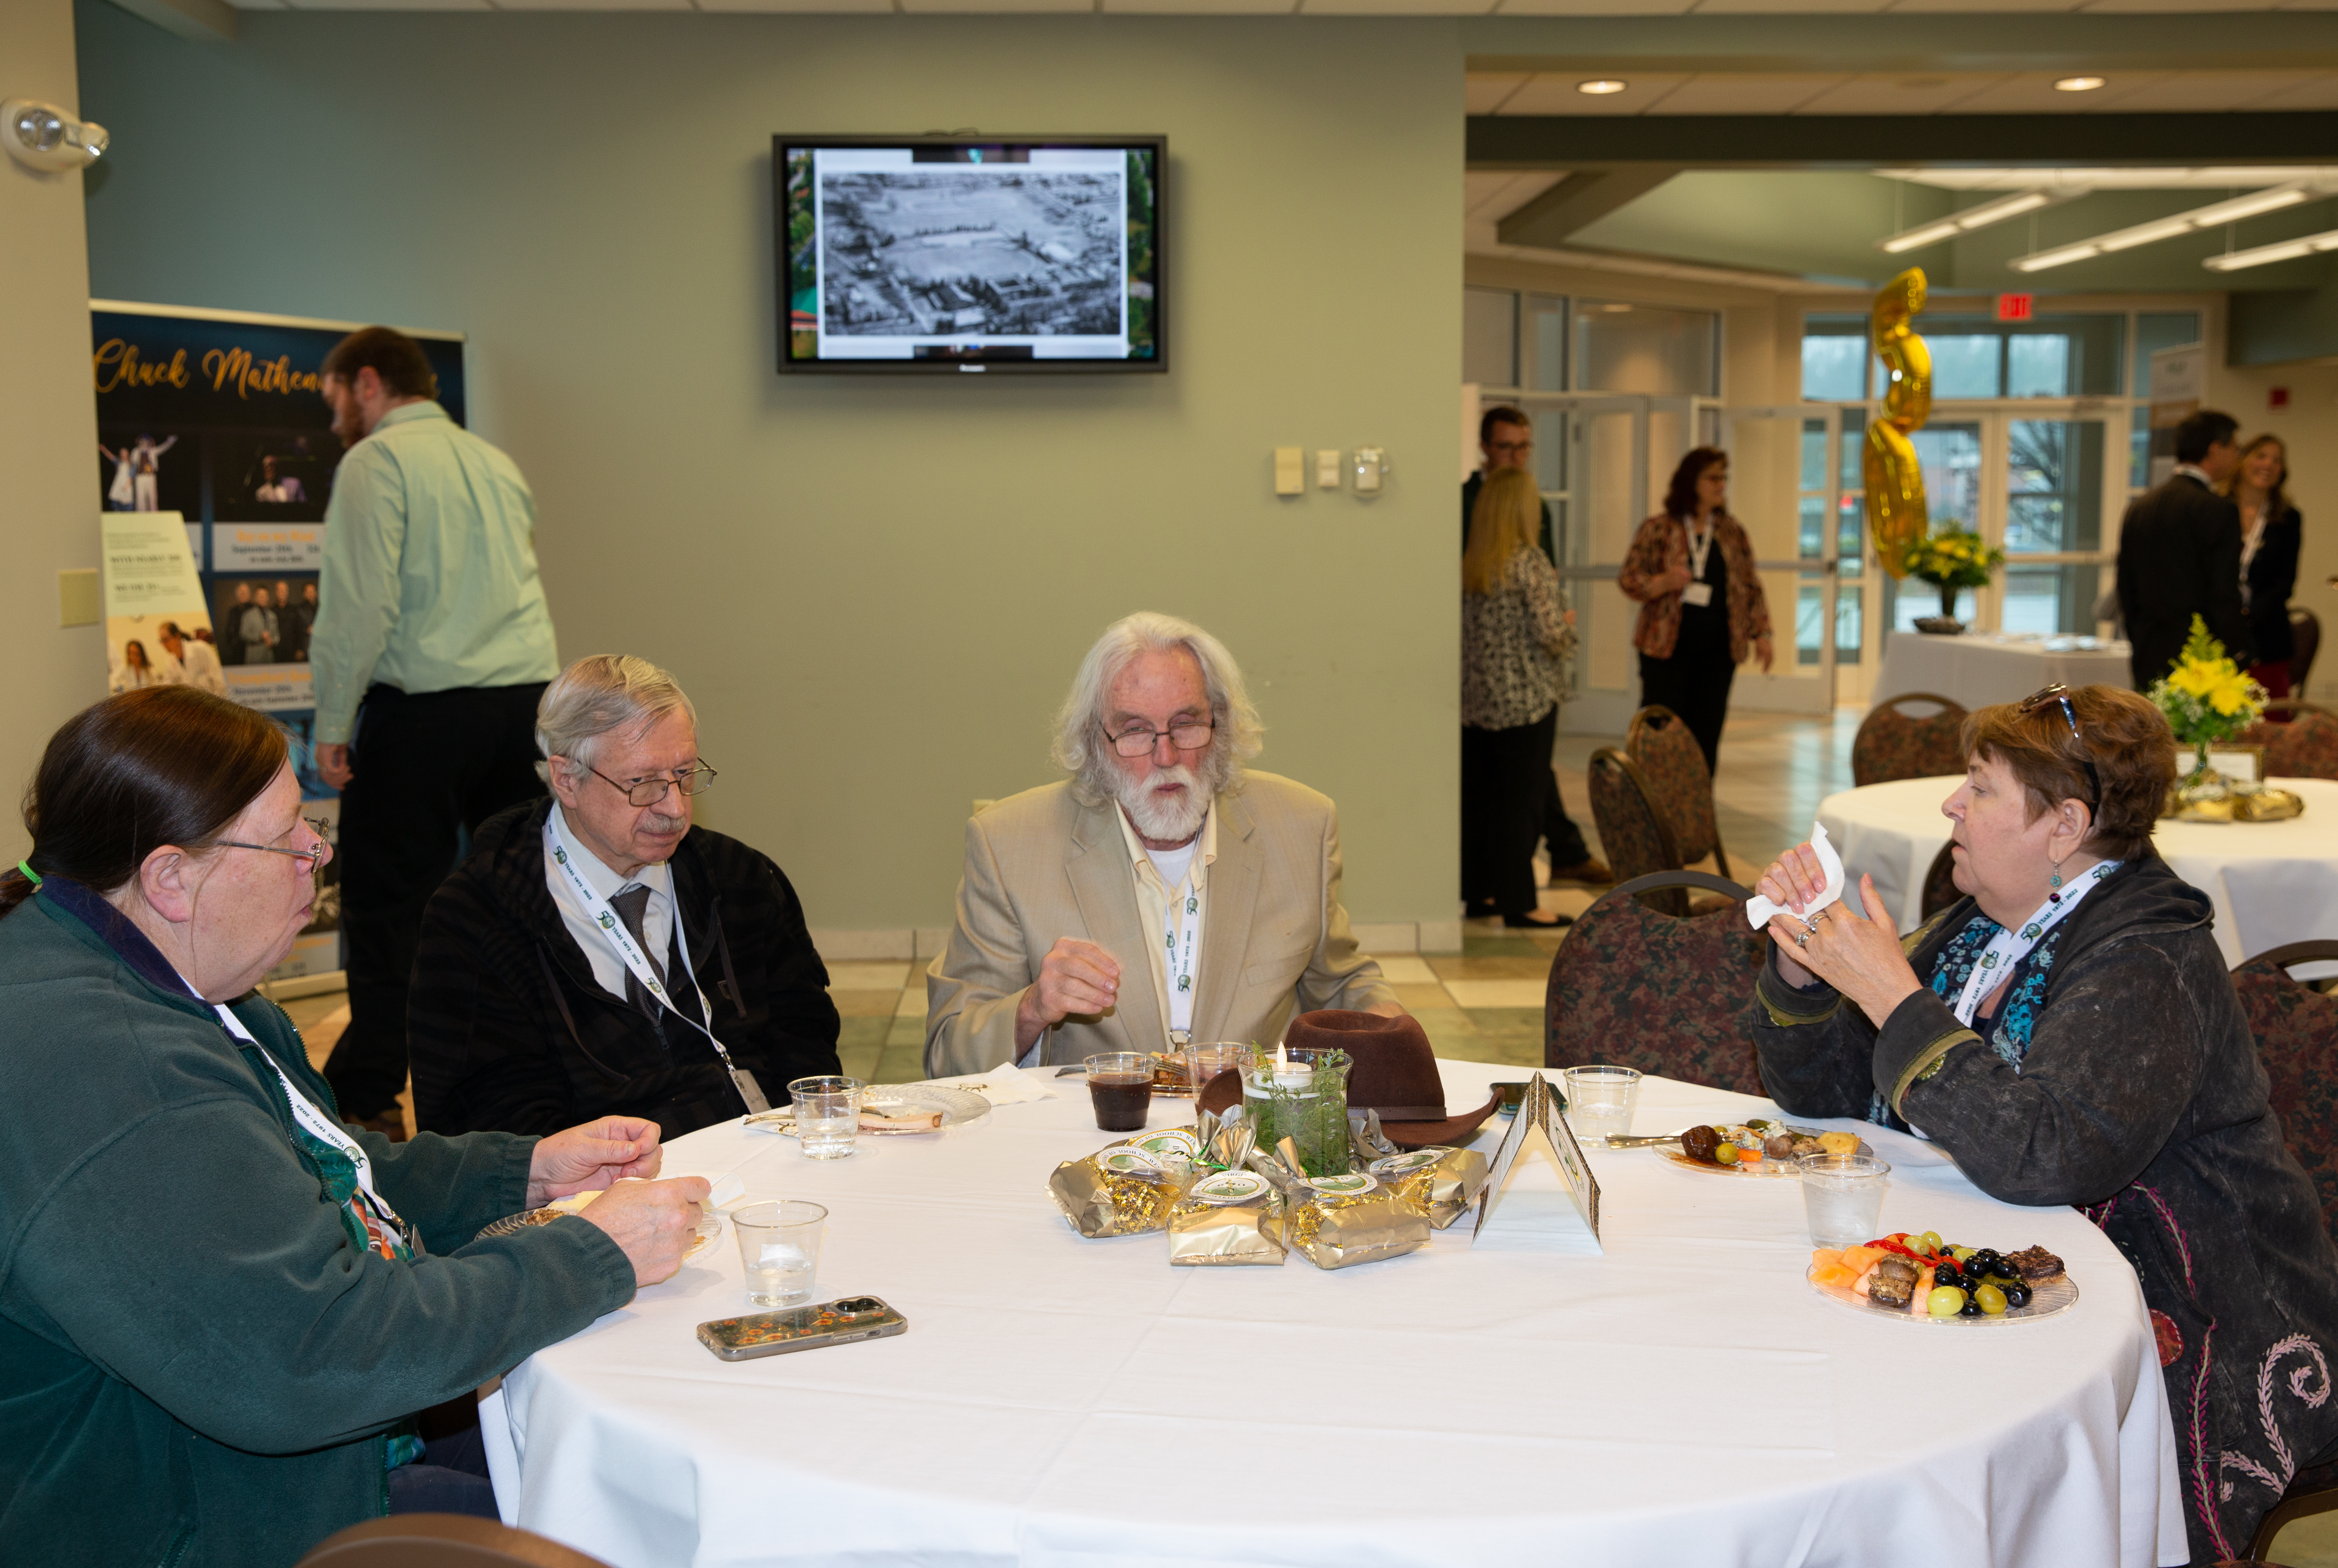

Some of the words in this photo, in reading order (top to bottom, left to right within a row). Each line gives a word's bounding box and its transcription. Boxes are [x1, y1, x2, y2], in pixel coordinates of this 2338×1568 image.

[93, 338, 191, 393] Chuck
[565, 862, 575, 876] YEARS
[2038, 911, 2053, 925] YEARS
[2065, 888, 2078, 900] 2022
[596, 910, 616, 929] 50
[612, 926, 623, 940] YEARS
[622, 940, 631, 951] 1972
[632, 953, 641, 965] 2022
[1978, 970, 1989, 985] YEARS
[296, 1104, 310, 1118] 2022
[313, 1120, 326, 1133] 1972
[327, 1133, 345, 1151] YEARS
[1116, 1149, 1146, 1158] SCHOOL
